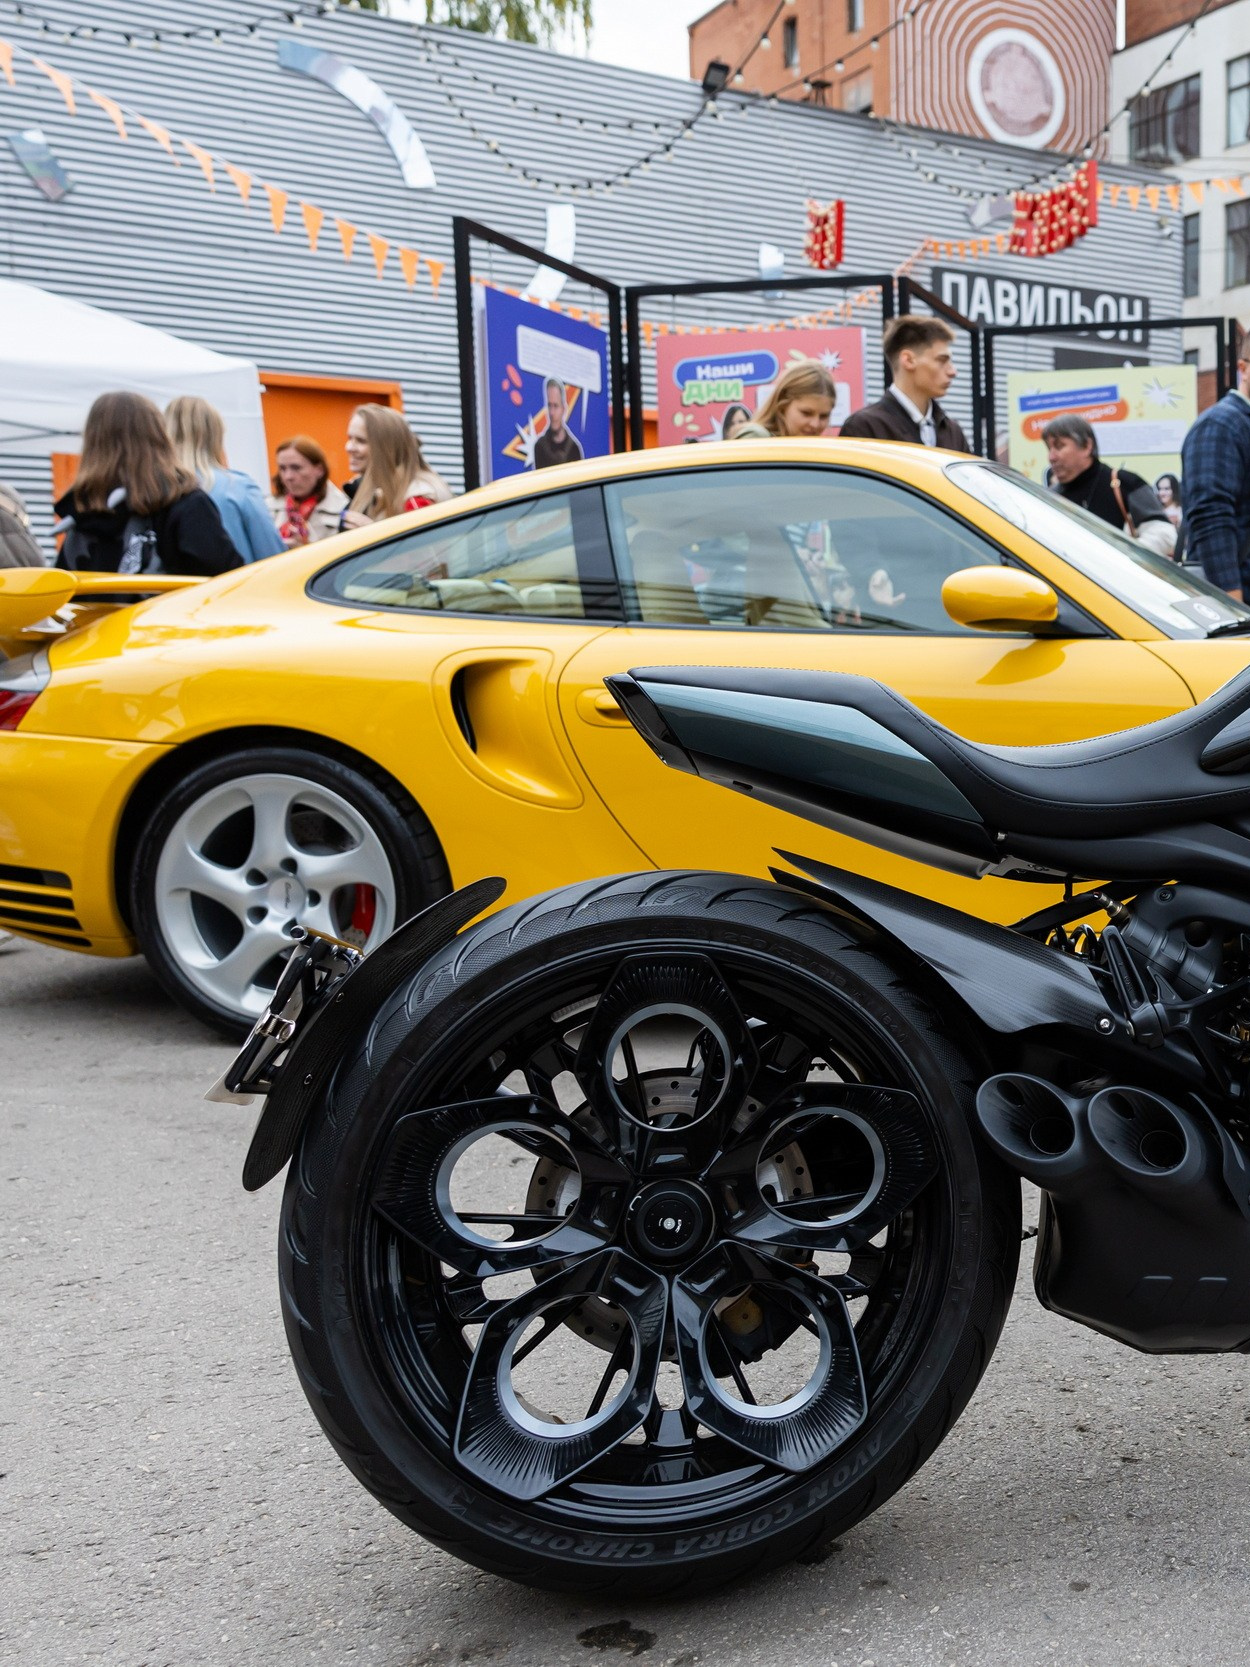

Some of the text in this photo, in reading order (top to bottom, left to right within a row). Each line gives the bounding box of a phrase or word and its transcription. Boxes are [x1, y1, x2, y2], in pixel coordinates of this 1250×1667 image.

[941, 271, 1144, 343] ПАВИЛЬОН
[696, 362, 754, 380] Наши
[486, 1437, 882, 1559] AVON COBRA CHROME
